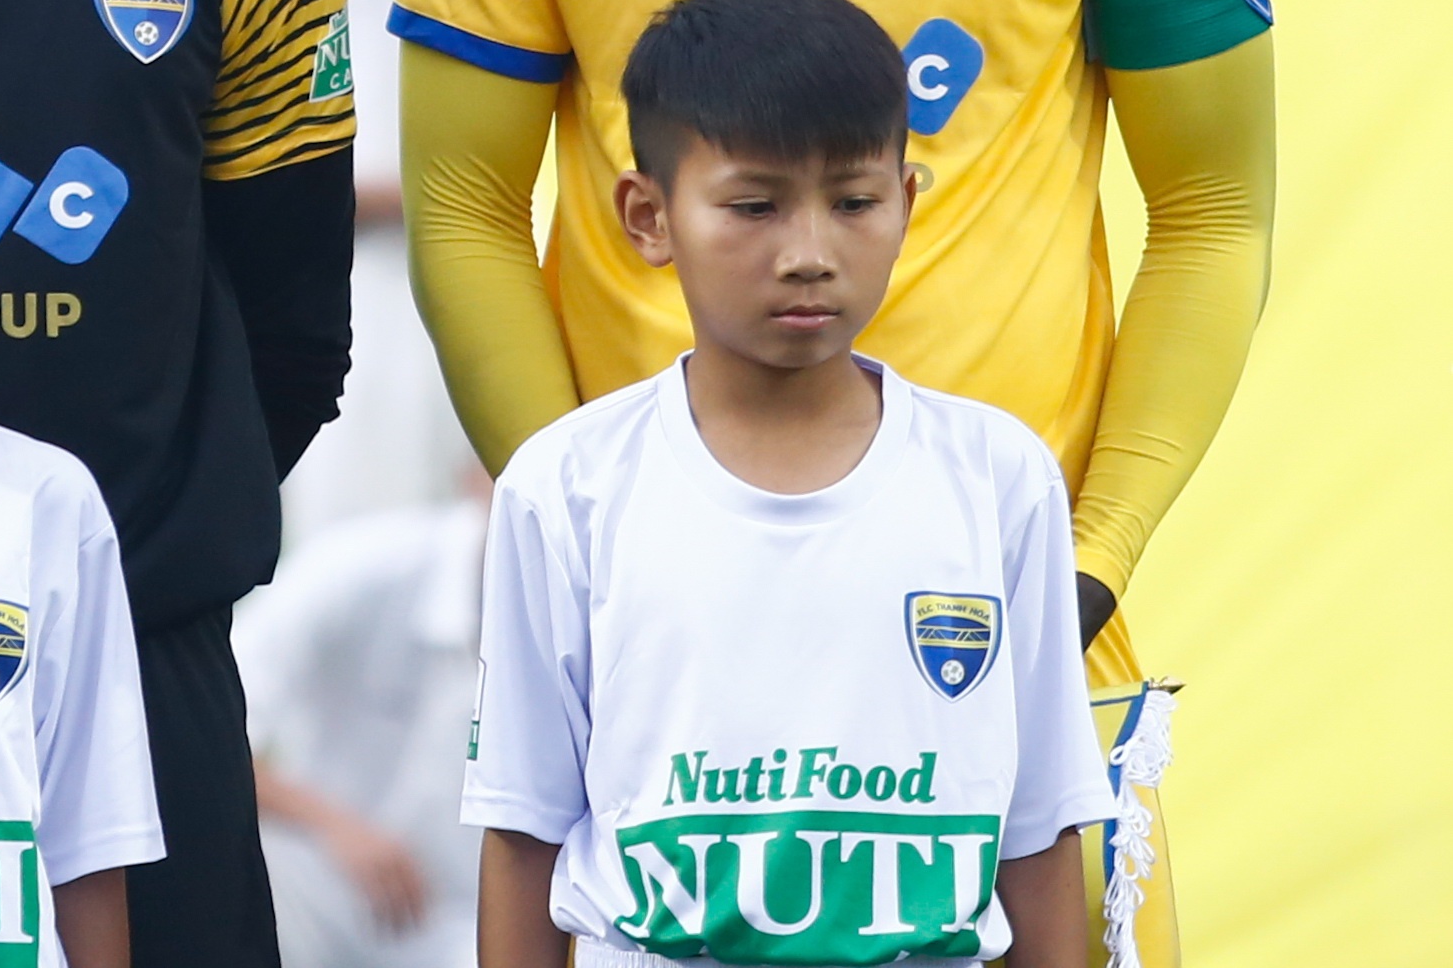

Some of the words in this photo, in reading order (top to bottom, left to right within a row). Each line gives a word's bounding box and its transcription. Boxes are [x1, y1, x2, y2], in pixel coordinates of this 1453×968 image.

[317, 32, 351, 74] NU
[936, 603, 967, 613] THANH
[662, 746, 938, 807] NutiFood
[619, 830, 995, 938] NUTI
